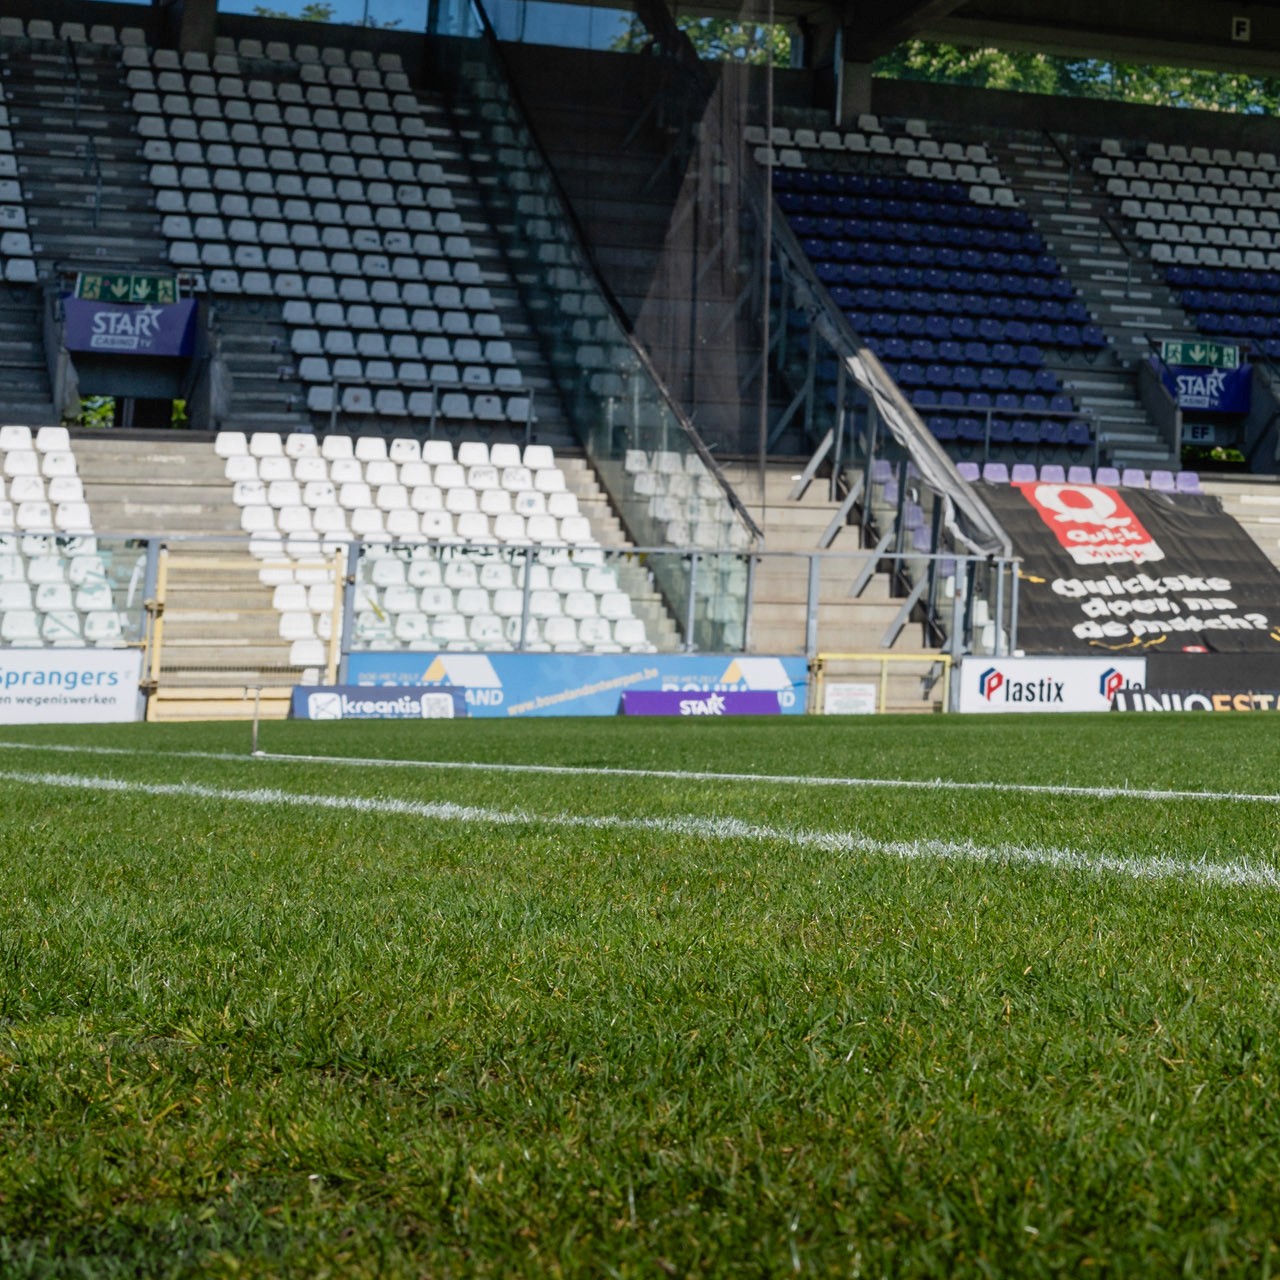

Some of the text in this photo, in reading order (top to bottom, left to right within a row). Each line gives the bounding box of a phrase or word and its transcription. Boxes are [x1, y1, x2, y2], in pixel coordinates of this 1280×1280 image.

[91, 311, 152, 337] STAR
[1176, 375, 1219, 397] STAR
[1066, 527, 1143, 543] Quick
[1072, 619, 1129, 640] de
[980, 666, 1065, 703] Plastix
[16, 693, 117, 707] wegeniswerken
[342, 694, 421, 715] kreantis
[679, 699, 723, 715] STAR
